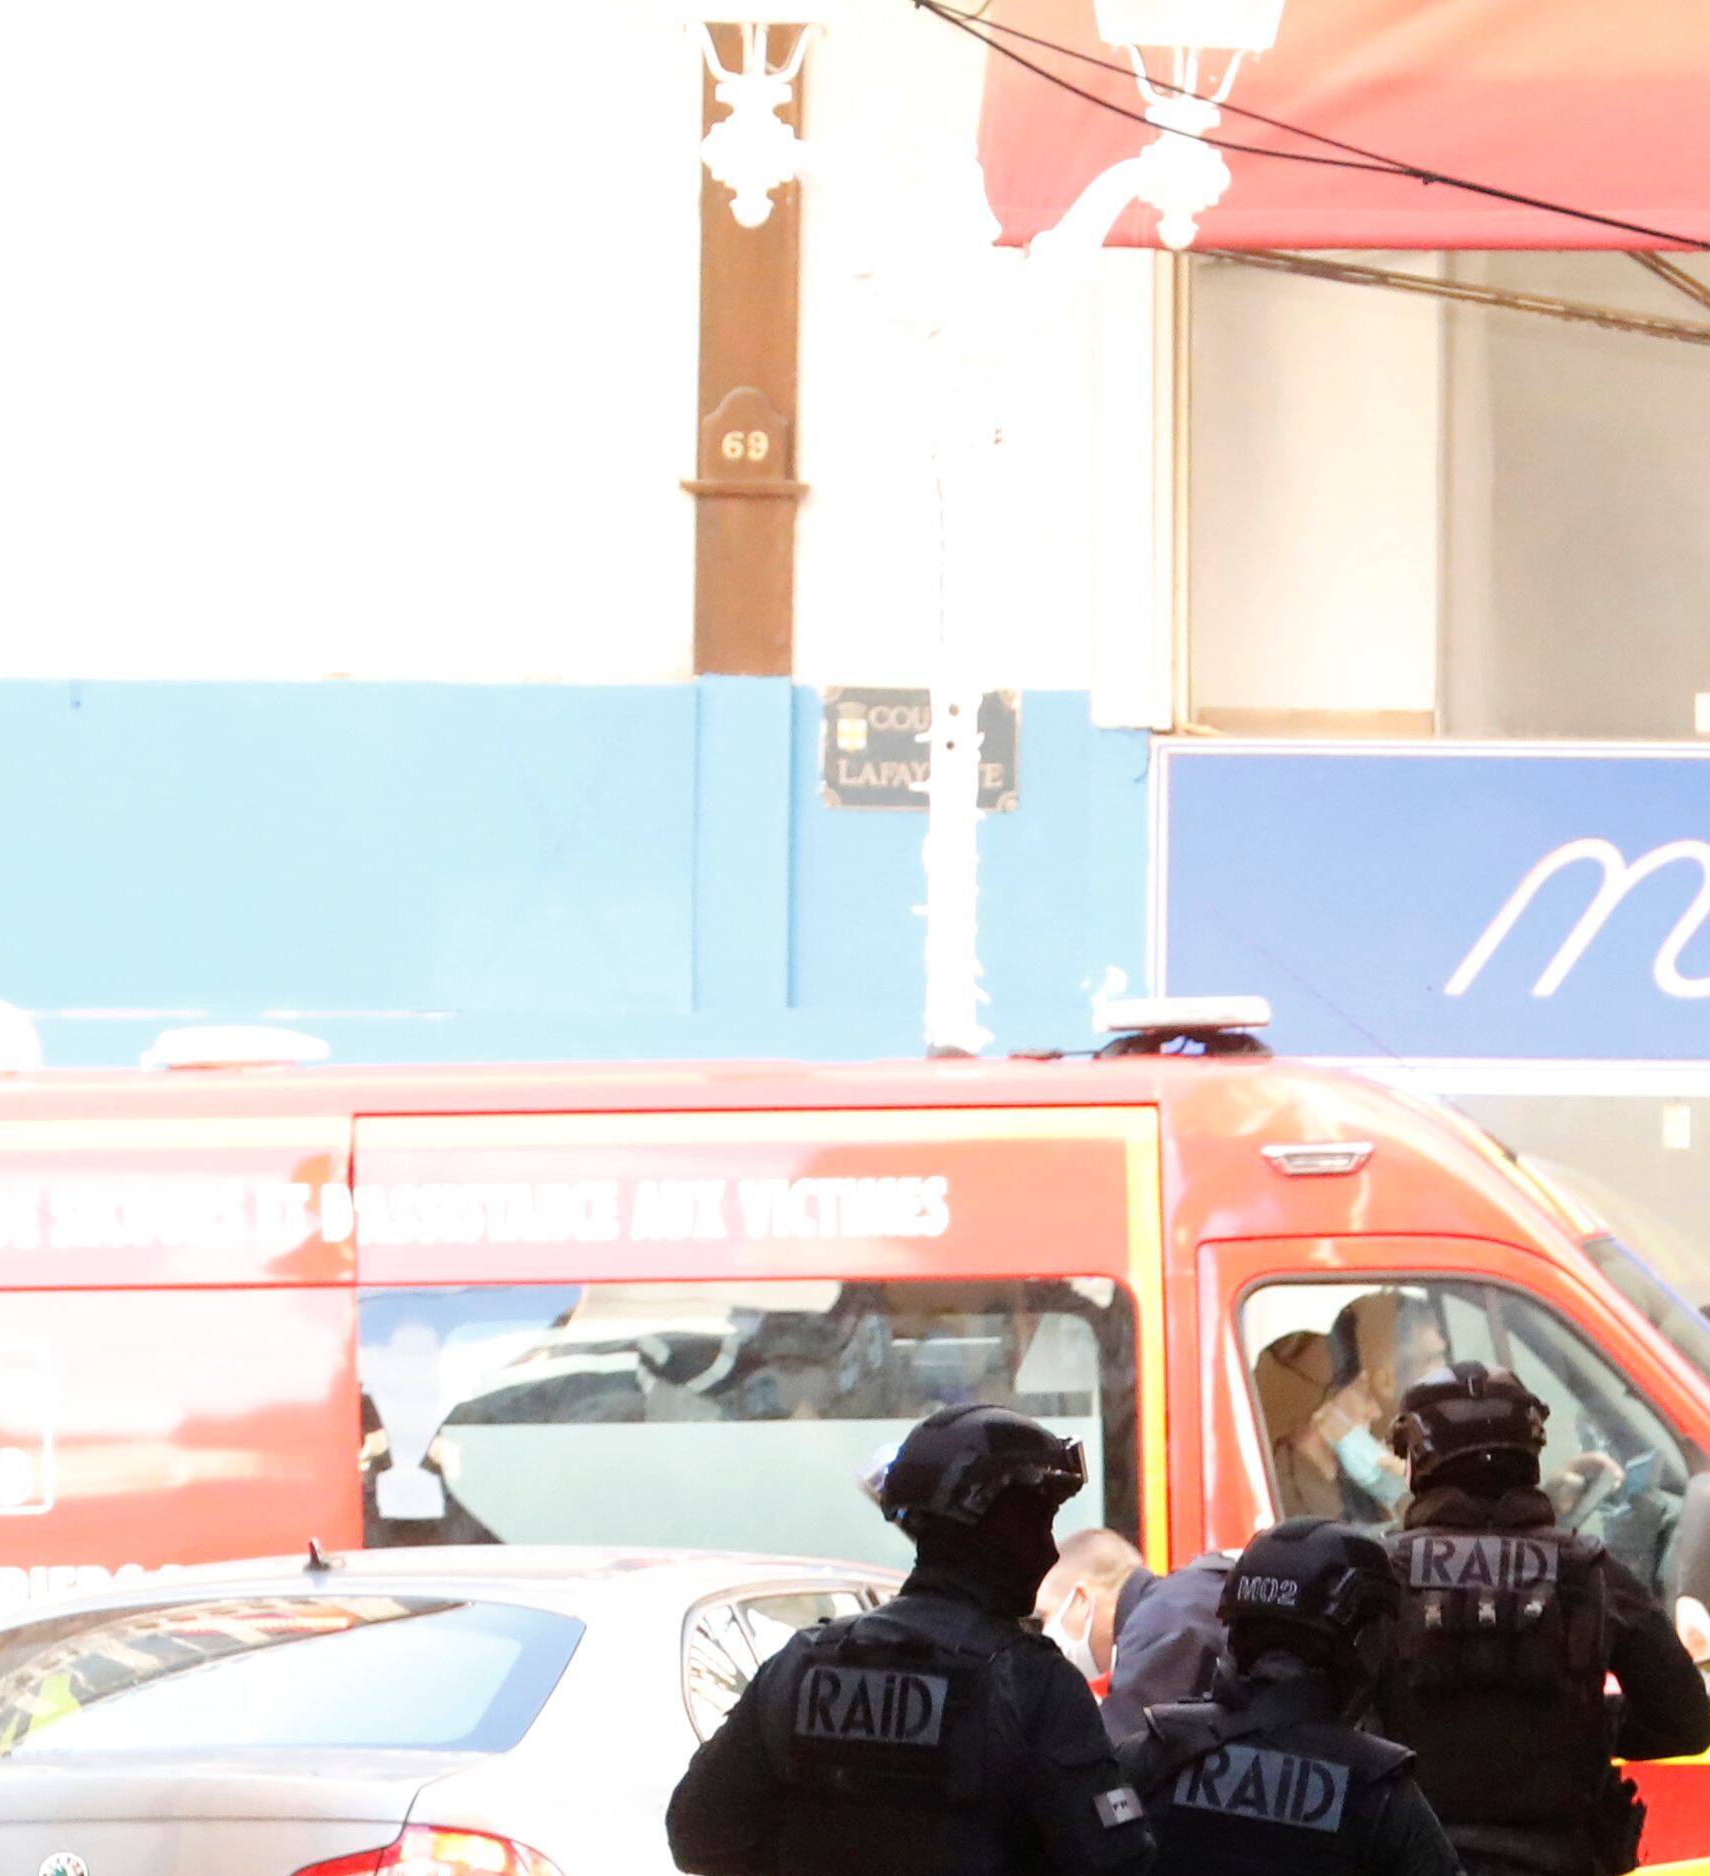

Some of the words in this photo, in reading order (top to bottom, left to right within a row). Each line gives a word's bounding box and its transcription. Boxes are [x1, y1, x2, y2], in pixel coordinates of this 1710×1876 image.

[721, 429, 770, 462] 69
[869, 705, 932, 732] COU
[838, 758, 1004, 787] LAFAYE
[1421, 1537, 1548, 1589] RAID
[806, 1669, 933, 1740] RAID
[1186, 1751, 1335, 1823] RAID
